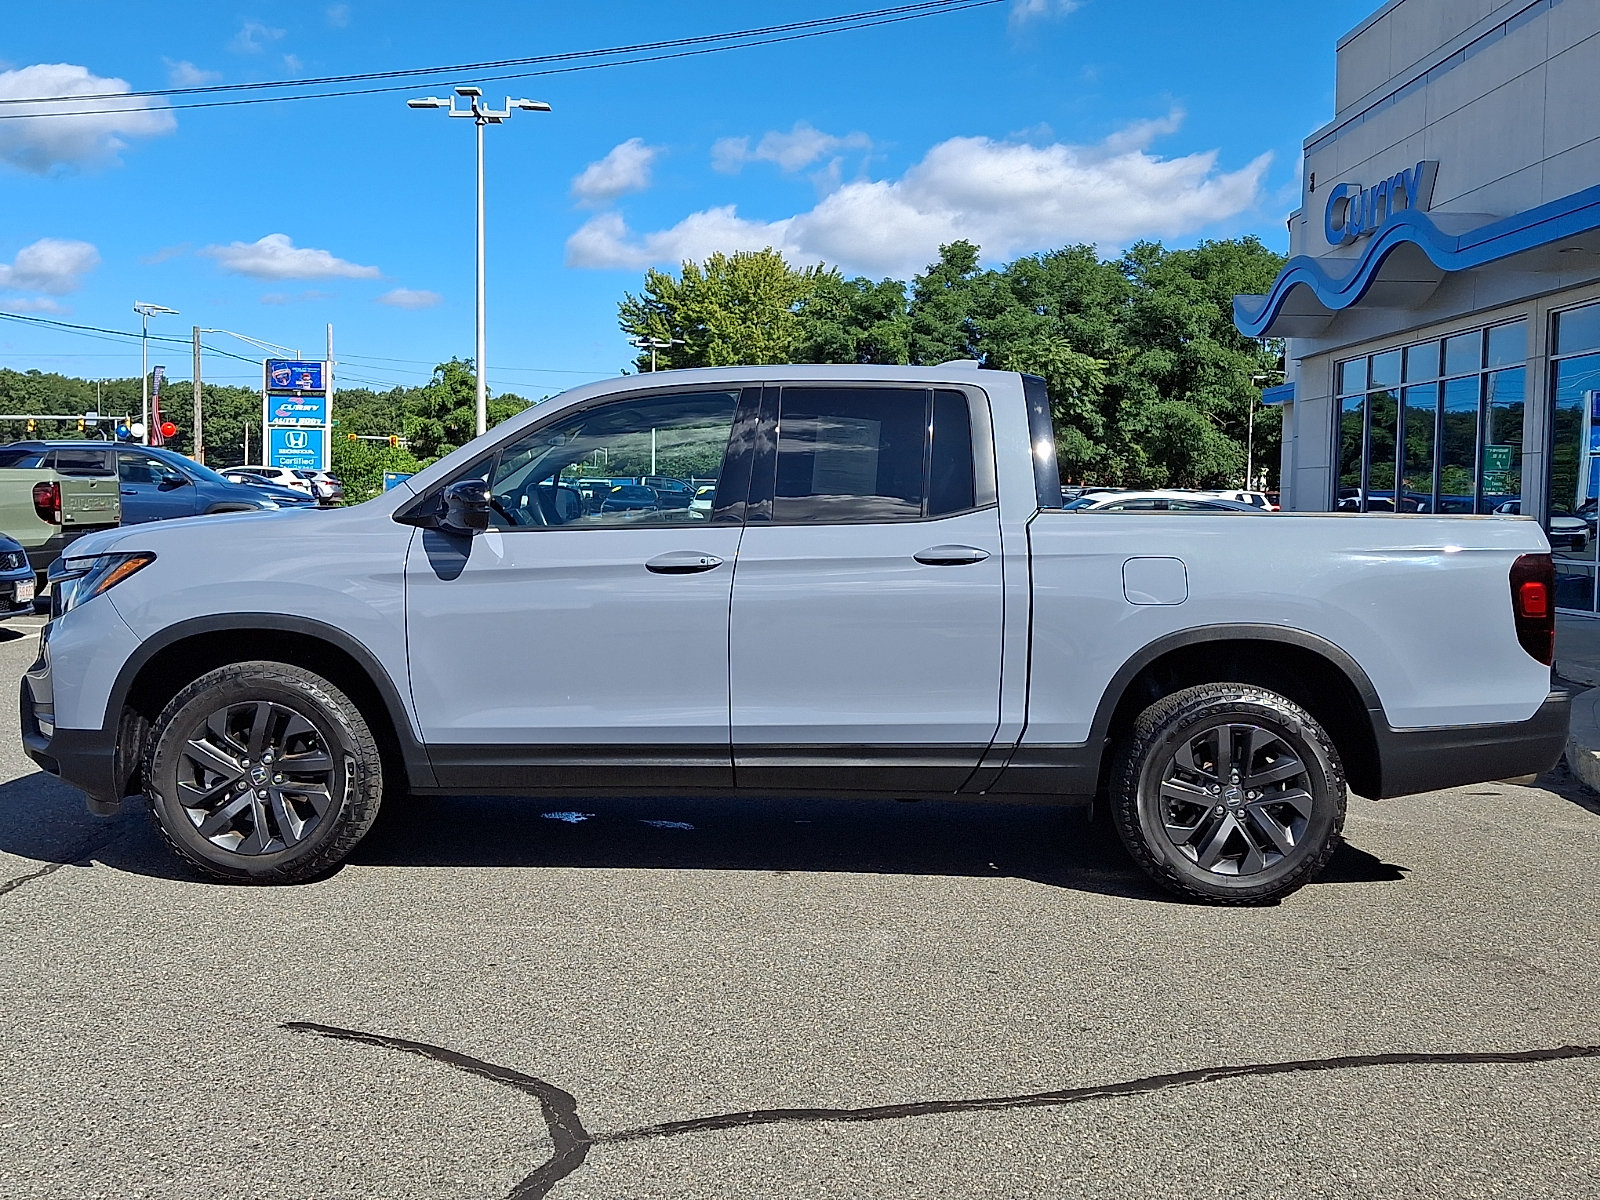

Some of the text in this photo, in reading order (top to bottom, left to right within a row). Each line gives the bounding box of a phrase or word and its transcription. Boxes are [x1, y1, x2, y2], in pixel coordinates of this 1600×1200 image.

[1324, 160, 1439, 245] Curry
[280, 403, 320, 411] CURRY
[280, 457, 314, 465] Certified
